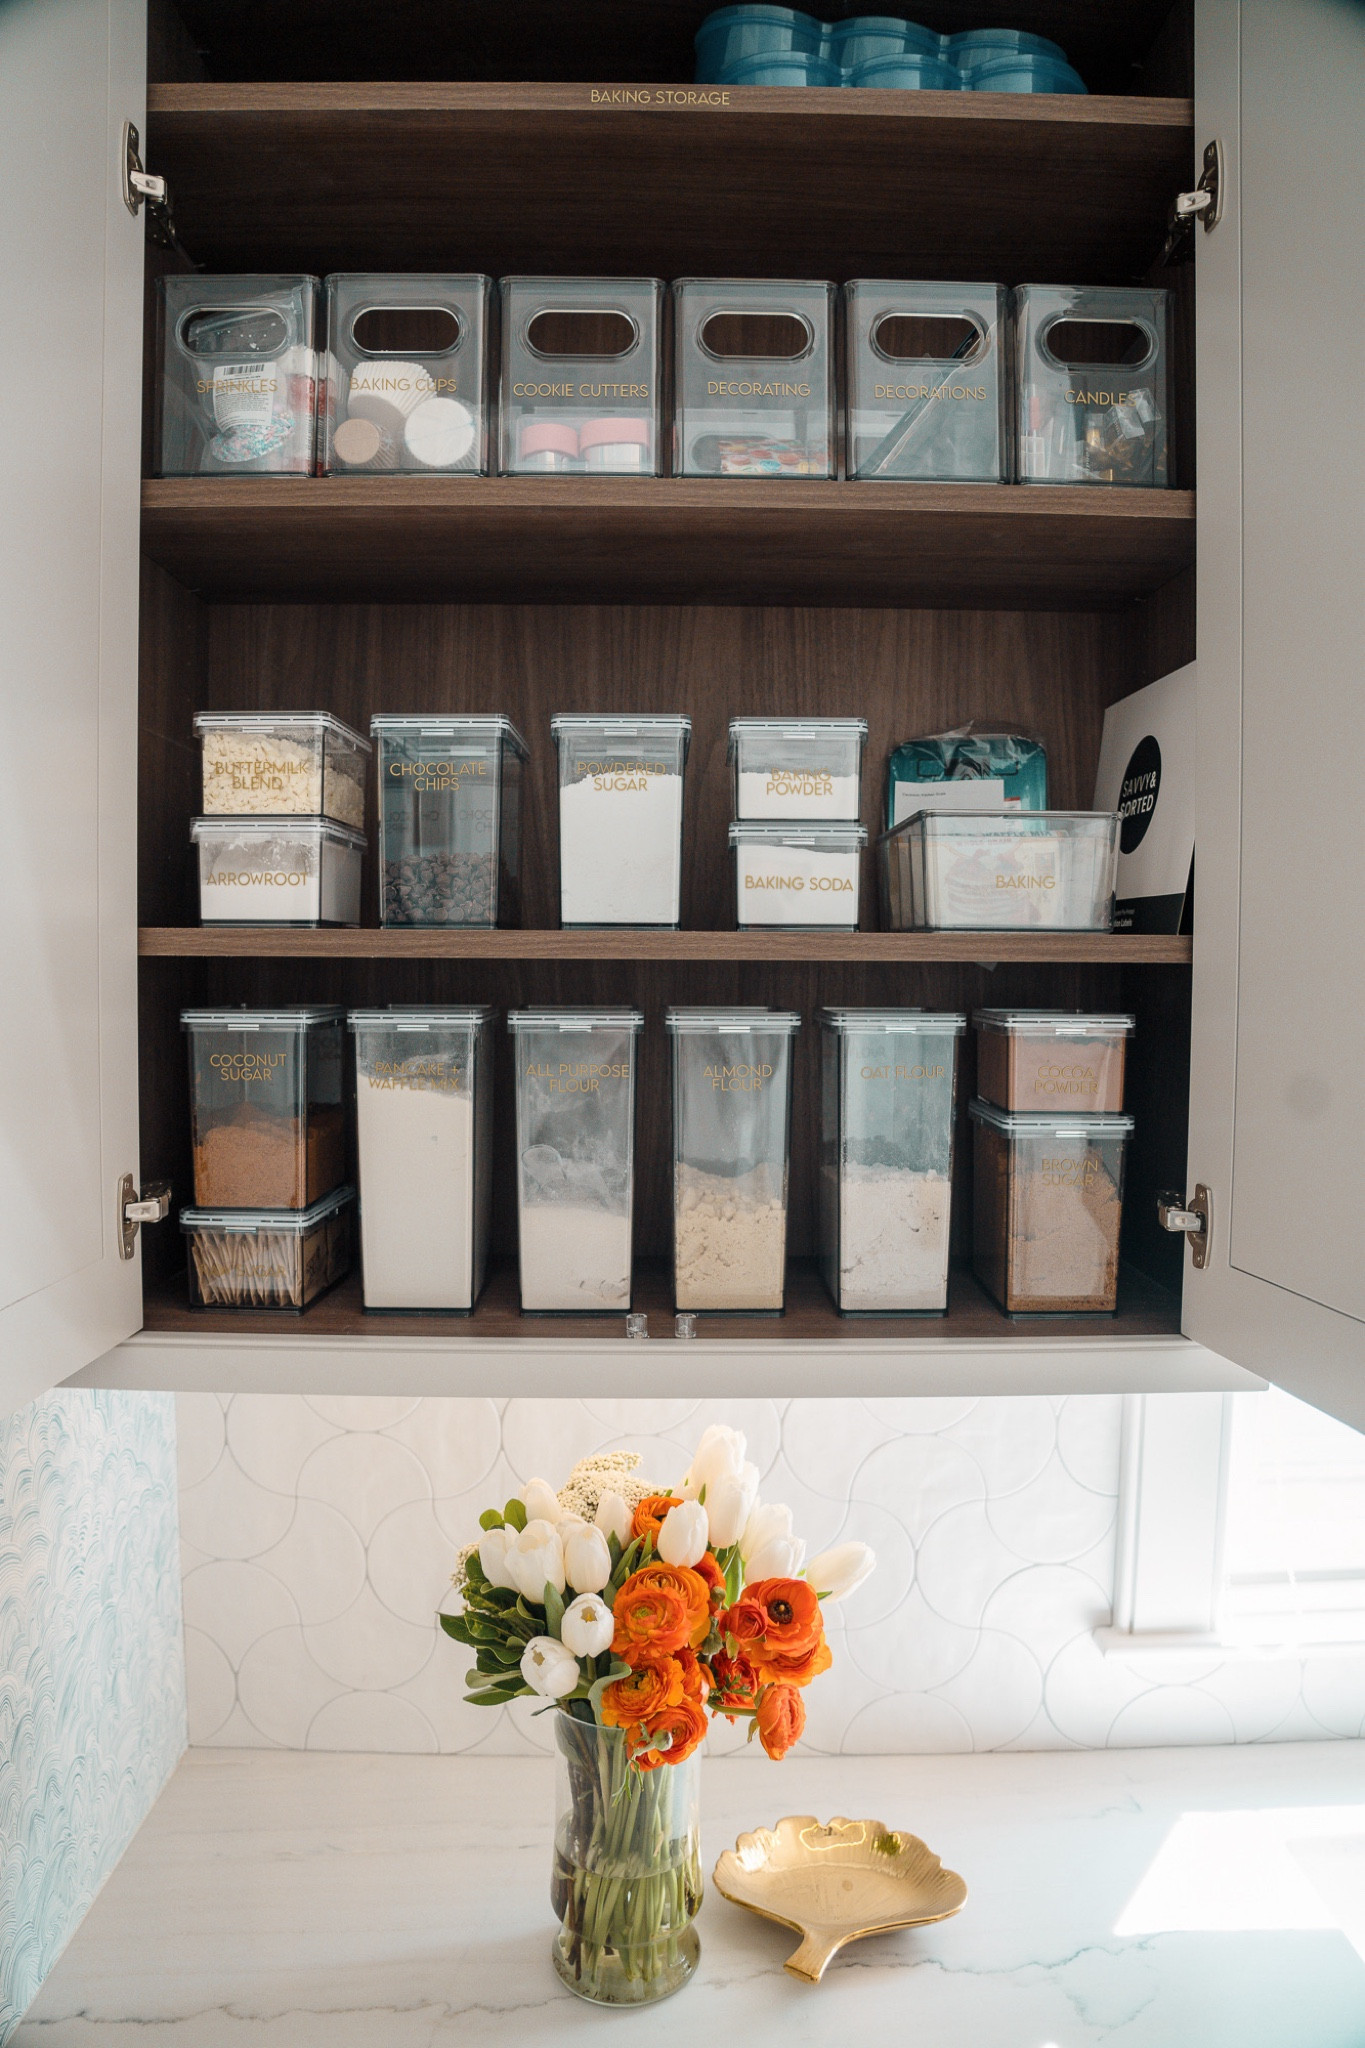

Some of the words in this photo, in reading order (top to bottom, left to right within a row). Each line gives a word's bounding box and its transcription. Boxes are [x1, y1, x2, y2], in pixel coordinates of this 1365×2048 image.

[590, 89, 651, 105] BAKING
[655, 90, 731, 107] STORAGE
[196, 379, 279, 394] SPRINKLES
[349, 377, 411, 392] BAKING
[415, 378, 458, 393] CUPS
[513, 383, 575, 398] COOKIE
[579, 383, 649, 399] CUTTERS
[707, 381, 812, 397] DECORATING
[874, 384, 988, 400] DECORATIONS
[1064, 389, 1137, 407] CANDLES
[215, 761, 309, 776] BUTTERMILK
[389, 761, 487, 777] CHOCOLATE
[577, 761, 667, 777] POWDERED
[771, 767, 832, 782] BAKING
[232, 776, 284, 791] BLEND
[414, 777, 461, 792] CHIPS
[593, 776, 649, 792] SUGAR
[766, 781, 834, 797] POWDER
[1120, 794, 1154, 817] SORTED
[206, 871, 309, 887] ARROWROOT
[744, 874, 805, 891] BAKING
[809, 876, 854, 892] SODA
[995, 874, 1056, 889] BAKING
[209, 1053, 287, 1068] COCONUT
[220, 1067, 272, 1082] SUGAR
[374, 1061, 447, 1077] PANCAKE
[525, 1063, 555, 1078] ALL
[558, 1063, 631, 1079] PURPOSE
[703, 1064, 774, 1079] ALMOND
[860, 1066, 892, 1079] OAT
[895, 1065, 945, 1080] FLOUR
[1038, 1065, 1095, 1080] COCOA
[368, 1076, 427, 1091] WAFFLE
[429, 1077, 460, 1091] MIX
[549, 1078, 600, 1094] FLOUR
[712, 1078, 763, 1092] FLOUR
[1034, 1079, 1101, 1095] POWDER
[1041, 1158, 1099, 1173] BROWN
[1041, 1173, 1095, 1188] SUGAR
